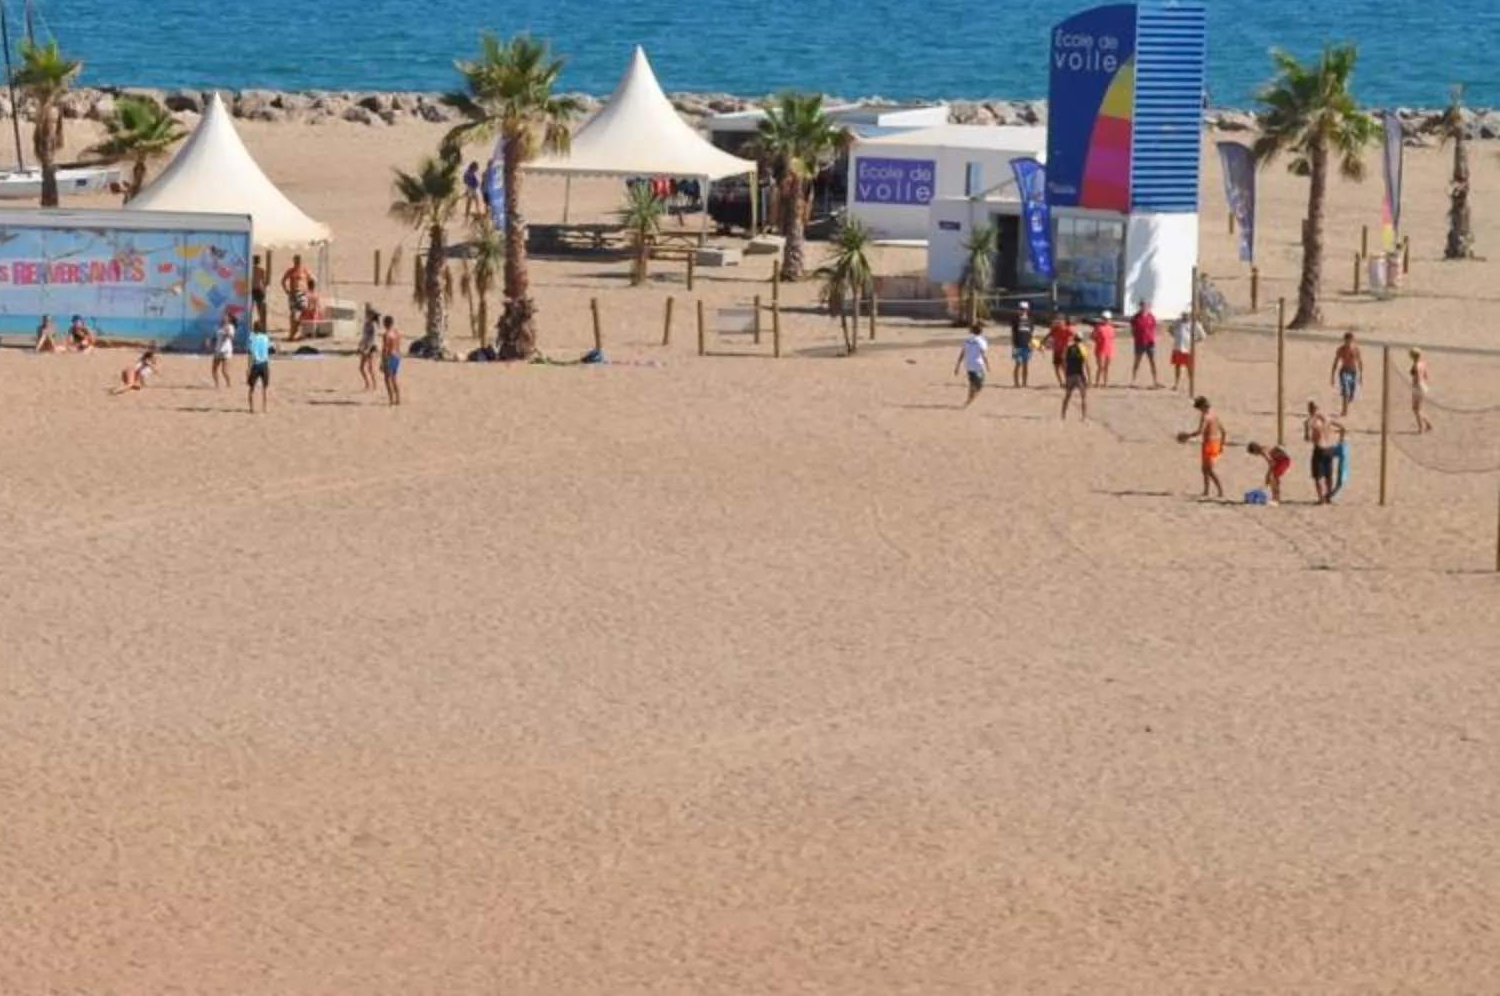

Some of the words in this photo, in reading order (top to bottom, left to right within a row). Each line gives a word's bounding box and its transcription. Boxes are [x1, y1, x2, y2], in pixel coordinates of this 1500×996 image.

[1098, 33, 1119, 50] de
[1055, 50, 1118, 74] voile
[909, 164, 932, 182] de
[859, 182, 931, 202] voile
